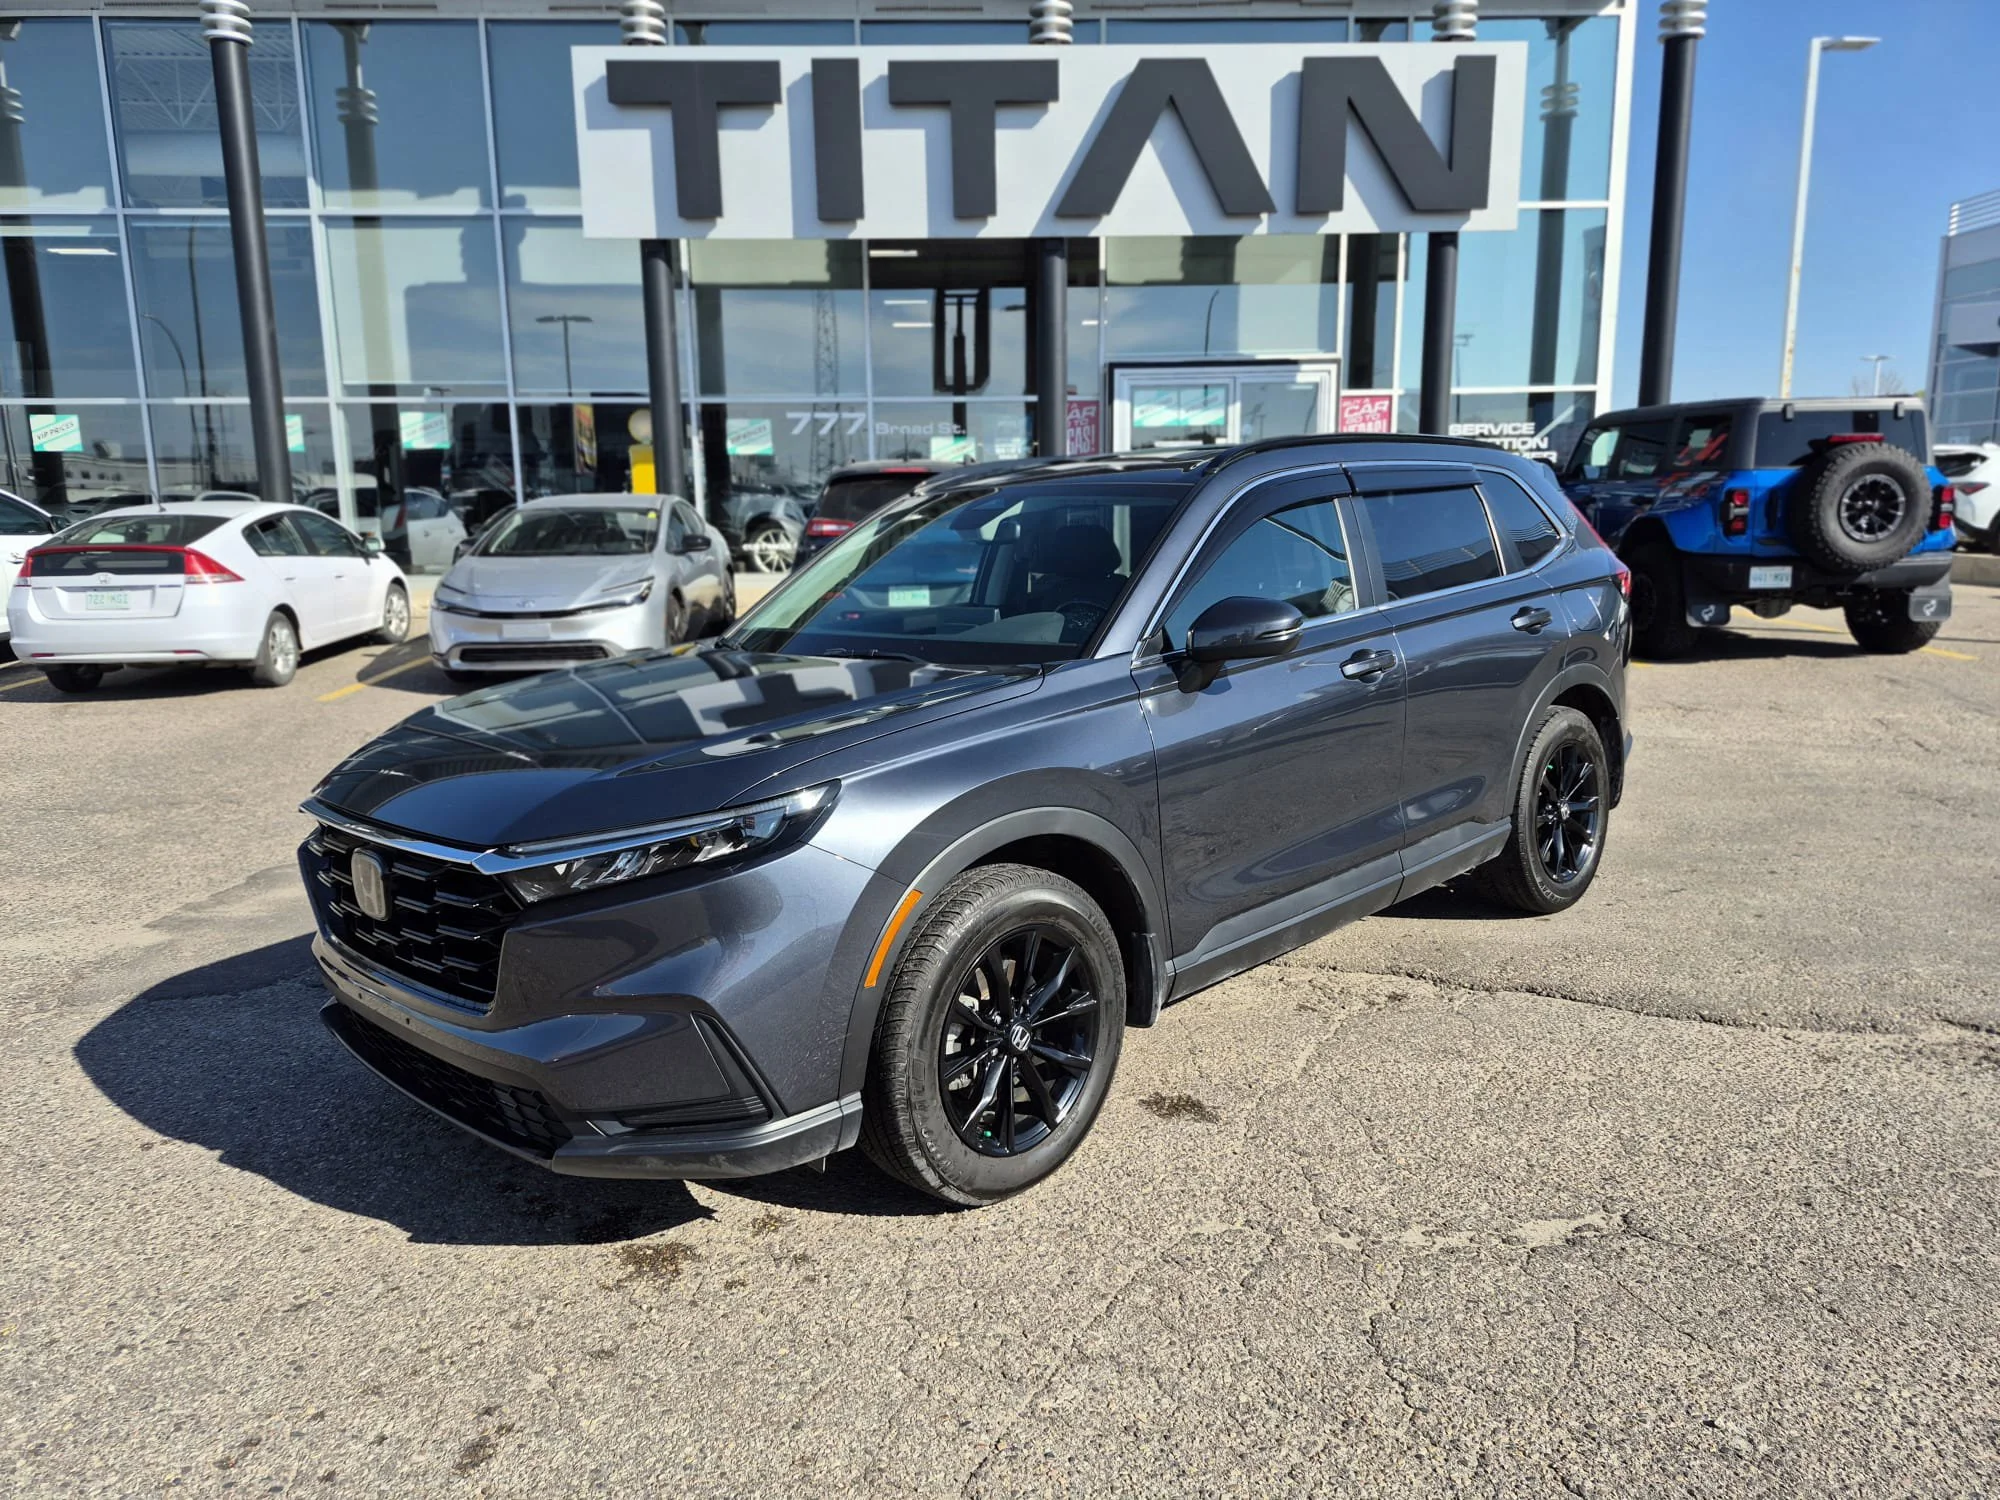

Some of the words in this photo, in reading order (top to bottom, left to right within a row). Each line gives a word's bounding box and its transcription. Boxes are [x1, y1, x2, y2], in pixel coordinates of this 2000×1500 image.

[605, 55, 1498, 222] TITAN
[1067, 406, 1097, 422] AR
[1344, 400, 1389, 418] CAR
[785, 411, 867, 436] 777
[874, 421, 935, 435] Broad
[937, 421, 968, 435] St.
[1448, 422, 1536, 436] SERVICE
